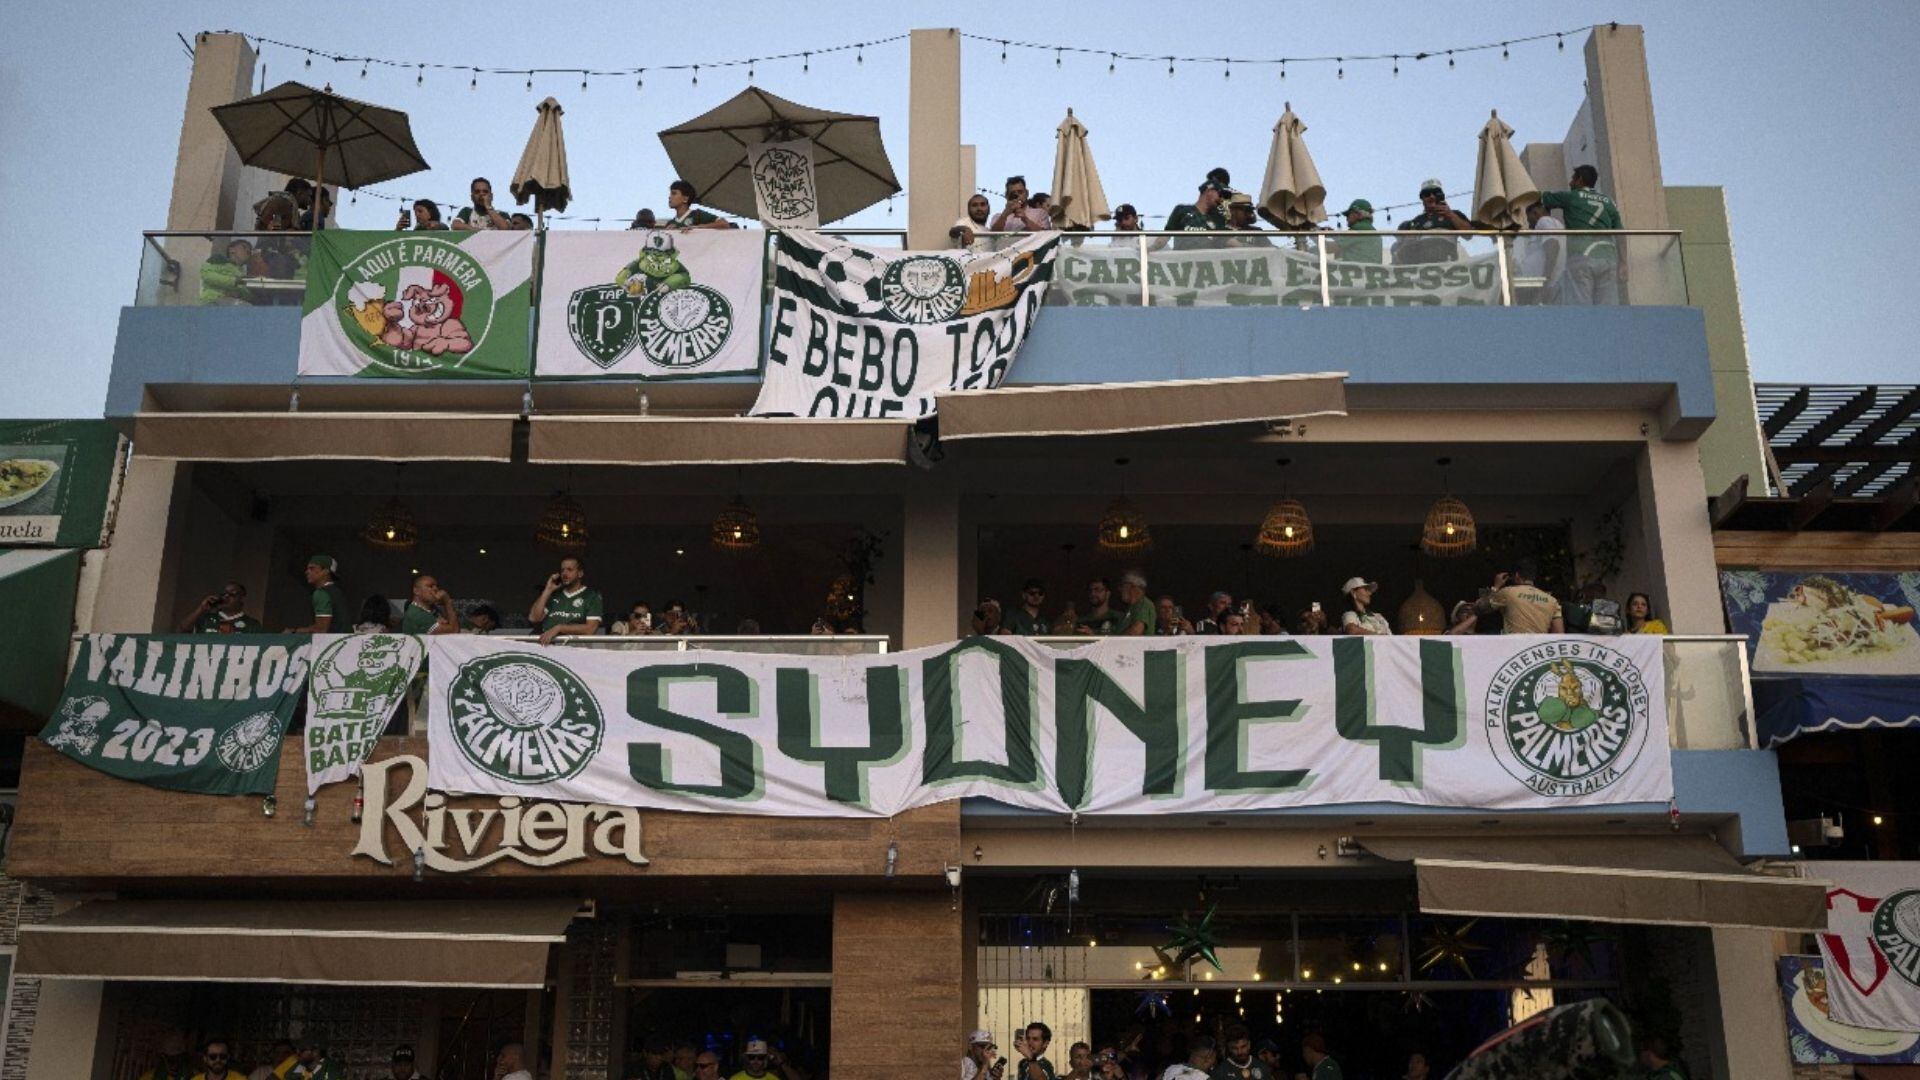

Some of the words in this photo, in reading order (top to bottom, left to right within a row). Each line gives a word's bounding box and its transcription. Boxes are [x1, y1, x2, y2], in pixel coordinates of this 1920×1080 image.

[1587, 200, 1604, 225] 7
[357, 249, 396, 280] AQUI
[399, 243, 408, 263] É
[413, 245, 483, 291] PARMERA
[1064, 256, 1273, 289] CARAVANA
[883, 284, 963, 323] PALMEIRAS
[640, 315, 728, 365] PALMEIRAS
[770, 296, 797, 366] E
[802, 308, 919, 397] BEBO
[87, 633, 312, 700] VALINHOS
[1488, 643, 1581, 728] PALMEIRENSES
[1589, 647, 1608, 661] IN
[1613, 656, 1647, 718] SYDNEY
[102, 718, 216, 766] 2023
[455, 698, 596, 776] PALMEIRAS
[626, 636, 1467, 810] SYDNEY
[1510, 706, 1628, 776] PALMEIRAS
[1526, 767, 1620, 795] AUSTRALIA
[351, 754, 650, 872] Riviera
